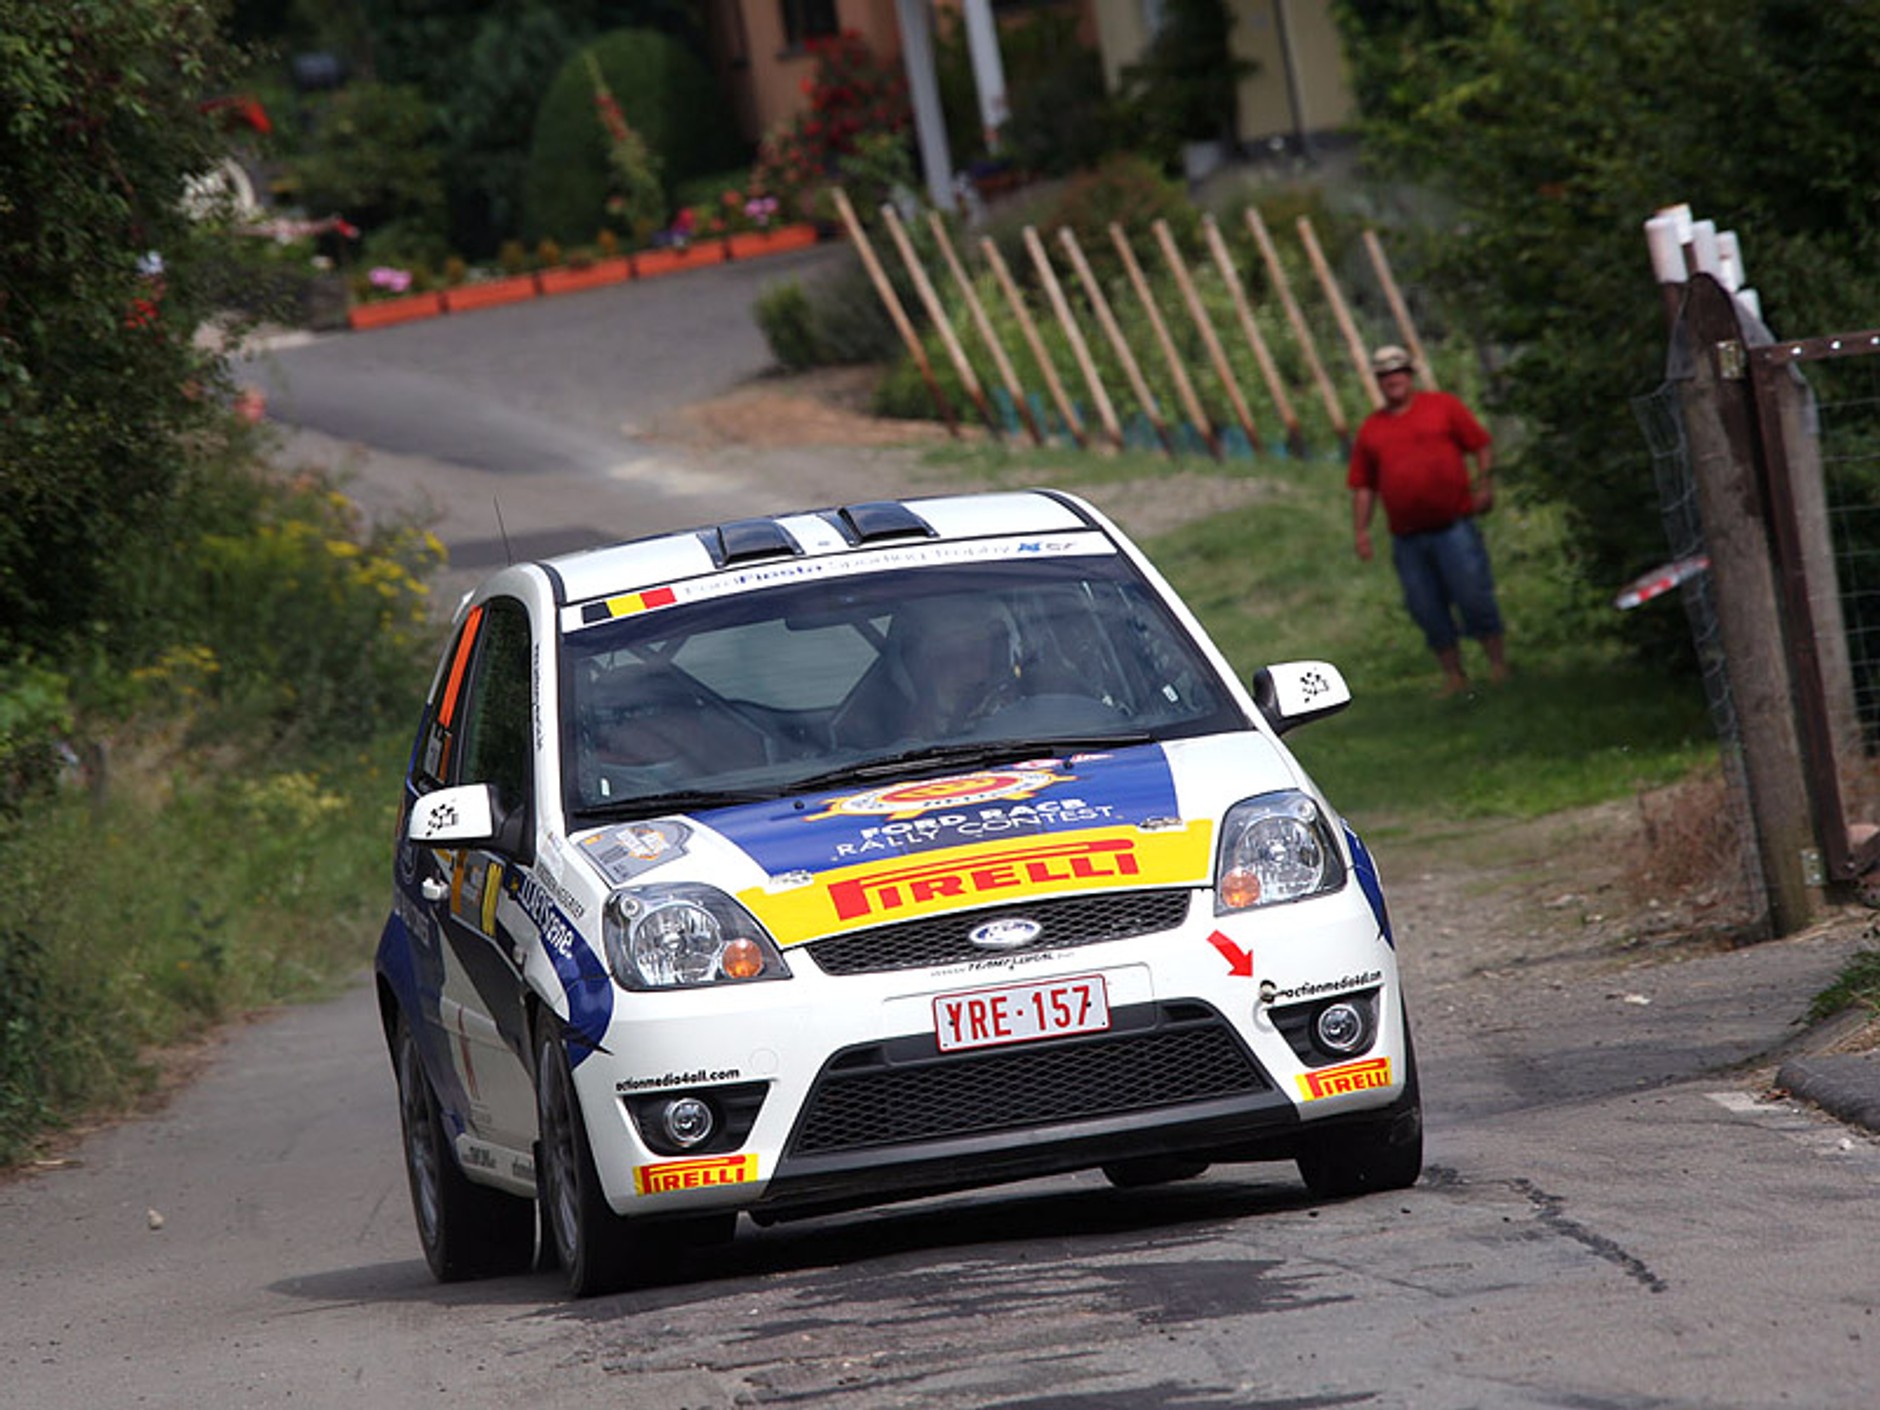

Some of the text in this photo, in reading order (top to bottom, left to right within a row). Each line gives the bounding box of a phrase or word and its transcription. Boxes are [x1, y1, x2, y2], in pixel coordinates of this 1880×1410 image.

[836, 805, 1113, 857] RALLY CONTEST
[861, 815, 967, 840] FORD
[828, 839, 1138, 922] PIRELLI
[615, 1068, 740, 1092] actionmedia4all.com
[1304, 1057, 1389, 1100] PIRELLI
[640, 1154, 747, 1195] PIRELLI
